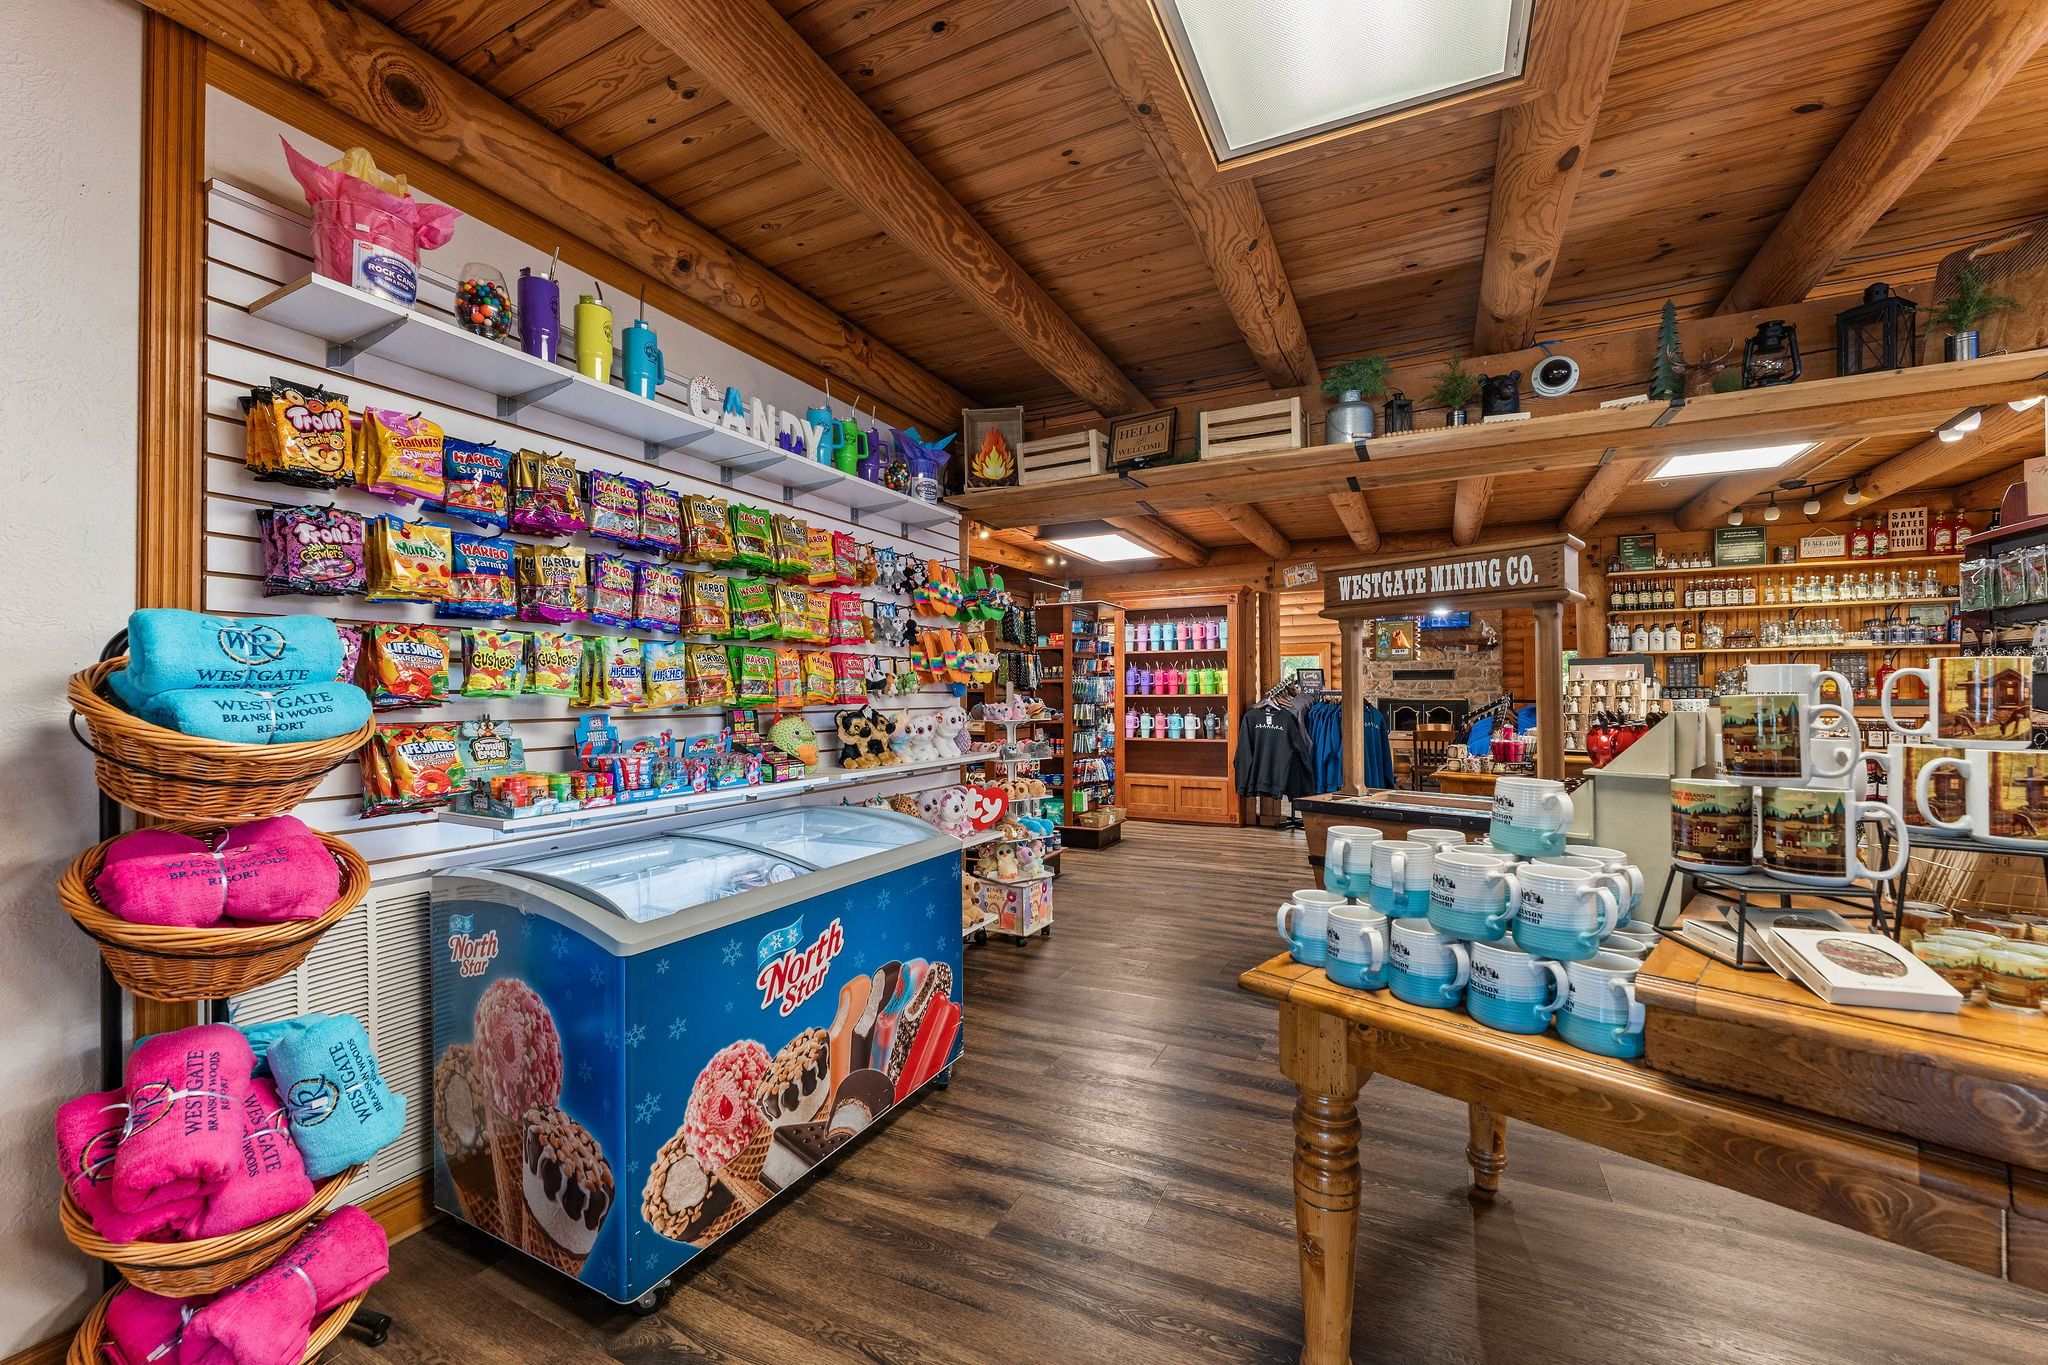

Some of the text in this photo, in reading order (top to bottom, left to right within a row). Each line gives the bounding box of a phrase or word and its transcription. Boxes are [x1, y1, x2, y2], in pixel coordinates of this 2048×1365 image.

[368, 263, 395, 278] ROCK
[397, 274, 416, 291] CANDY
[285, 405, 343, 431] Trolli
[687, 373, 825, 462] CANDY
[1119, 422, 1165, 440] HELLO
[390, 435, 442, 448] Starburst
[1118, 441, 1164, 457] WELCOME
[453, 451, 504, 469] HARIBO
[460, 465, 501, 479] Starmix
[596, 480, 634, 498] HARIBO
[646, 490, 676, 507] HARIBO
[740, 512, 766, 526] HARIBO
[1891, 511, 1924, 520] SAVE
[1891, 520, 1925, 529] WATER
[294, 522, 350, 544] Trolli
[808, 535, 828, 544] ARIBO
[1892, 529, 1924, 538] DRINK
[1892, 538, 1925, 548] TEQUILA
[300, 549, 344, 561] Crawlers
[461, 544, 508, 560] HARIBO
[467, 558, 508, 570] Starmix
[542, 556, 580, 568] HARIBO
[1338, 554, 1539, 601] WESTGATE MINING CO.
[698, 582, 725, 593] HARIBO
[739, 585, 764, 596] HARIBO
[809, 598, 826, 608] ARIBO
[386, 642, 443, 658] LIFE SAVERS
[417, 657, 442, 666] CANDY
[471, 651, 516, 670] Gushers
[537, 650, 578, 669] Gushers
[696, 654, 724, 663] HARIBO
[745, 654, 771, 665] HARIBO
[811, 656, 833, 669] HARIBO
[196, 669, 310, 683] WESTGATE
[610, 666, 641, 678] HI-CHEW
[213, 691, 334, 712] WESTGATE
[222, 704, 333, 723] BRANSON WOODS
[256, 720, 307, 734] RESORT
[398, 740, 456, 755] LIFE SAVERS
[475, 741, 506, 752] Crawly
[430, 752, 455, 761] CANDY
[1685, 791, 1716, 800] BRANSON
[966, 787, 1002, 824] ty
[164, 847, 289, 869] WESGATE
[169, 856, 289, 881] BRANSON WOODS
[1431, 890, 1455, 903] BRANSON
[1519, 908, 1543, 919] RANSON
[448, 929, 498, 963] North
[459, 958, 489, 978] Star
[756, 916, 844, 1011] North
[778, 962, 831, 1017] Star
[1471, 979, 1499, 993] BRANSON
[346, 1038, 368, 1080] WOODS
[209, 1051, 221, 1093] WOODS
[329, 1040, 373, 1125] WESTGATE
[185, 1049, 204, 1137] WESTGATE
[244, 1094, 282, 1174] WESTGATE
[243, 1140, 259, 1178] WOODS
[281, 1248, 320, 1280] REORT
